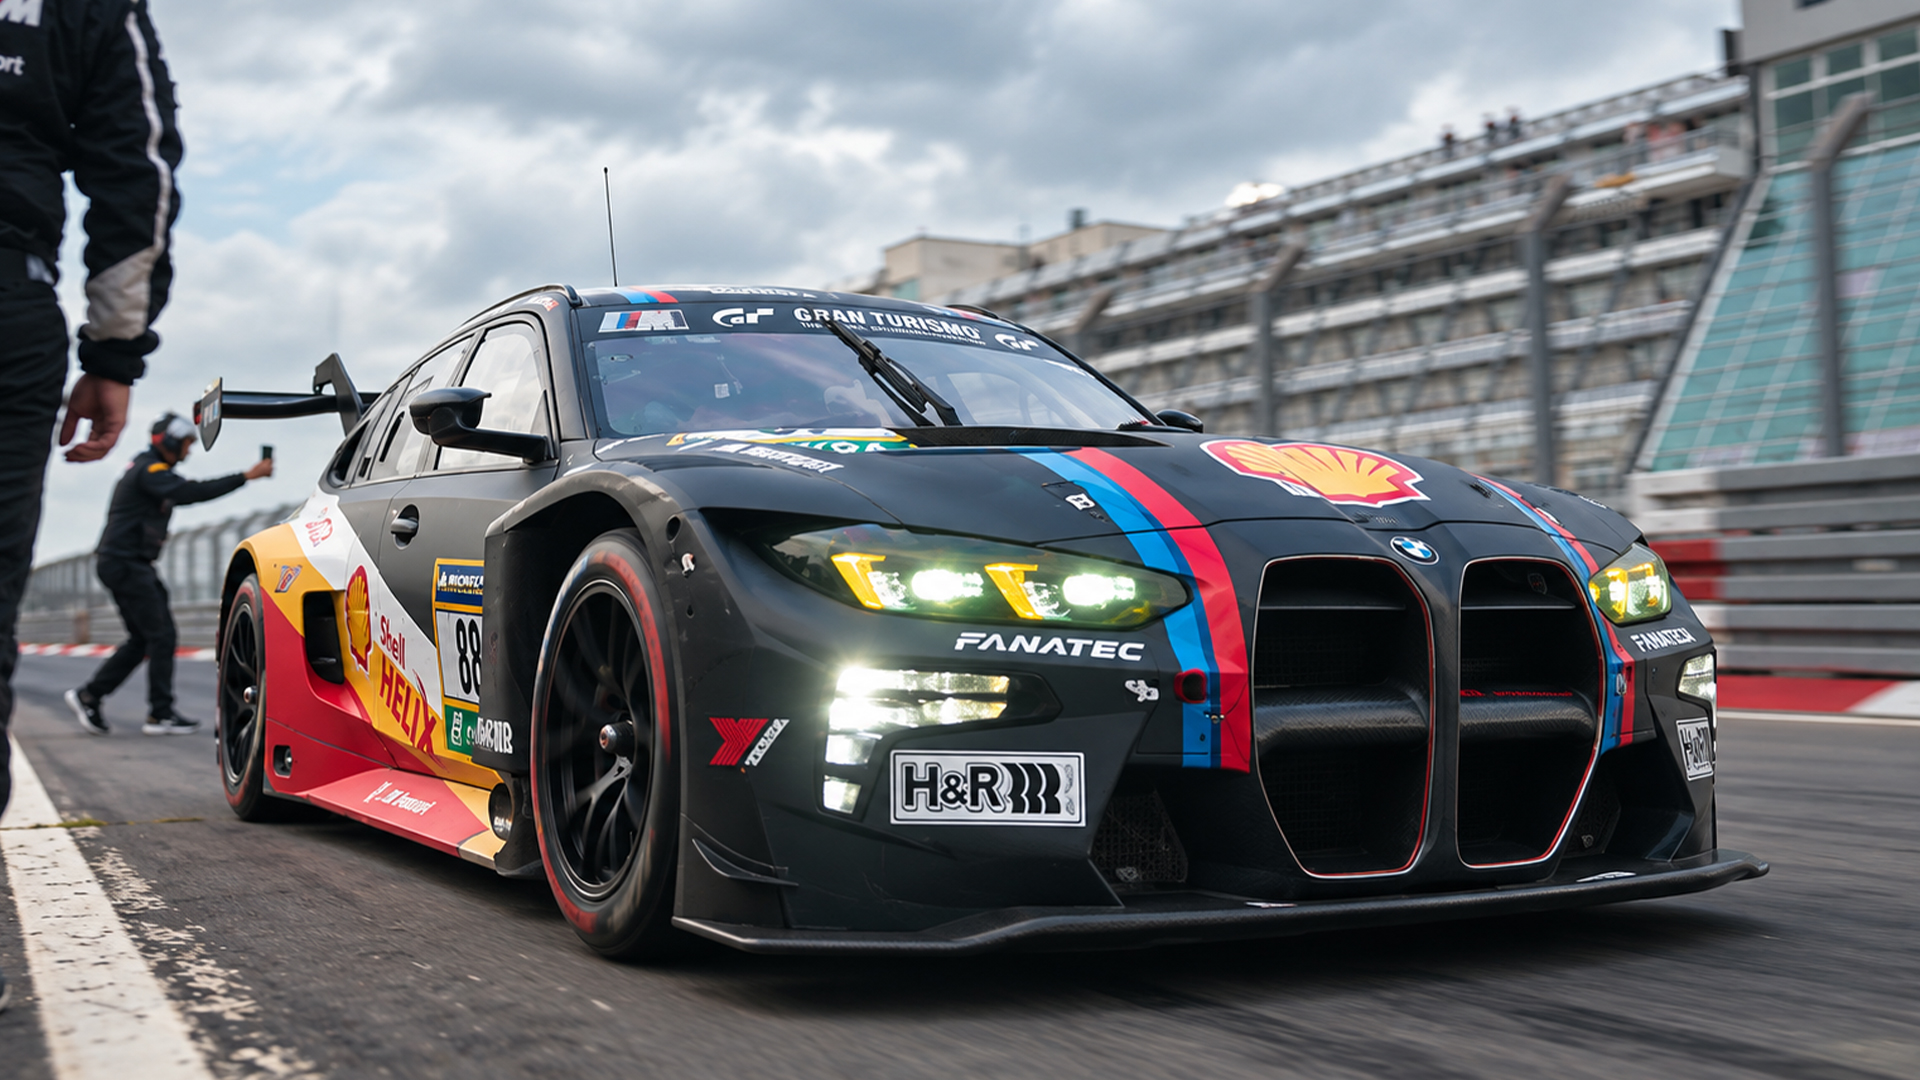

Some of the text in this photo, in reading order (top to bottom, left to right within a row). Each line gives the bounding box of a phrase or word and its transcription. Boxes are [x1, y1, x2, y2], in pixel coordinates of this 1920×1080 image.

[793, 307, 866, 325] GRAN
[869, 311, 981, 339] TURISMO
[380, 615, 406, 670] Shell
[455, 618, 482, 696] 88
[954, 632, 1145, 661] FANATEC
[379, 652, 437, 757] HELIX
[902, 762, 1006, 812] H&R
